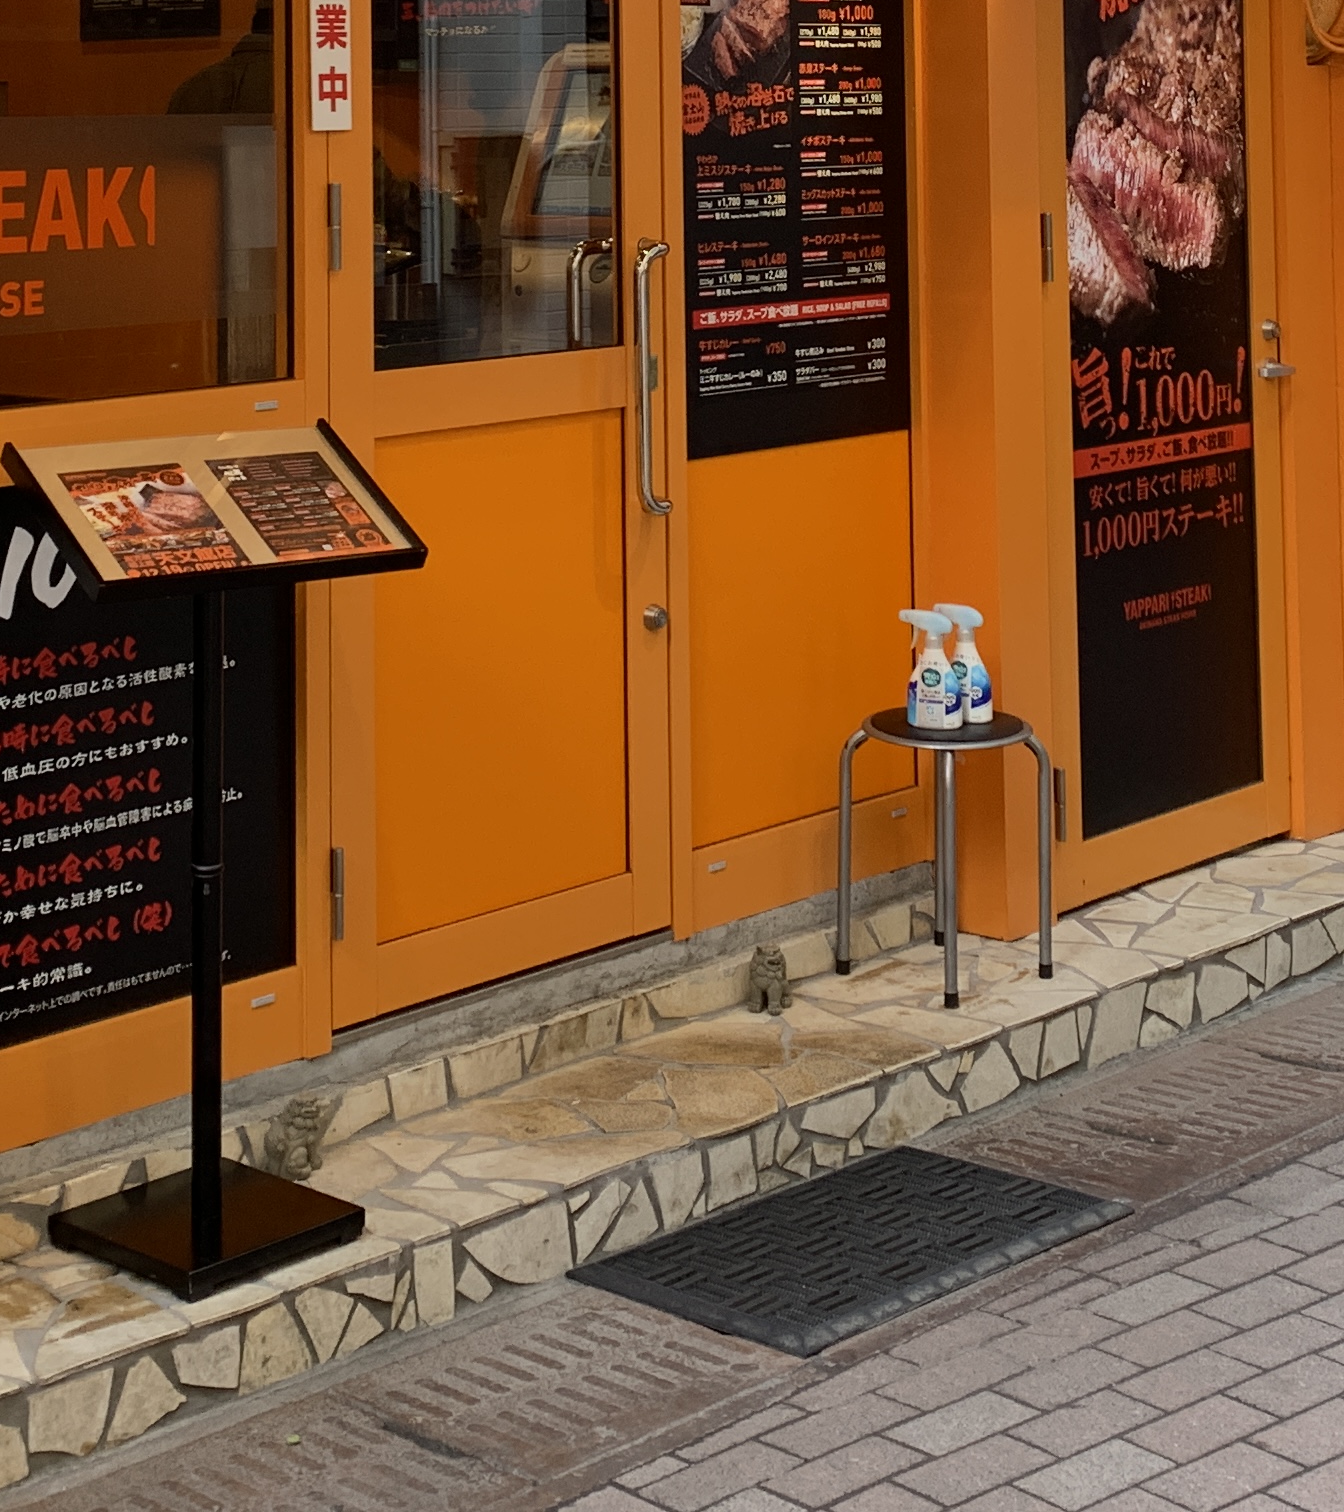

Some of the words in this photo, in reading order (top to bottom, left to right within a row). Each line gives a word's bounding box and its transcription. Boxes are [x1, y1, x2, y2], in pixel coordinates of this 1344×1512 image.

[1135, 345, 1176, 371] これで
[1123, 593, 1171, 622] YAPPARI
